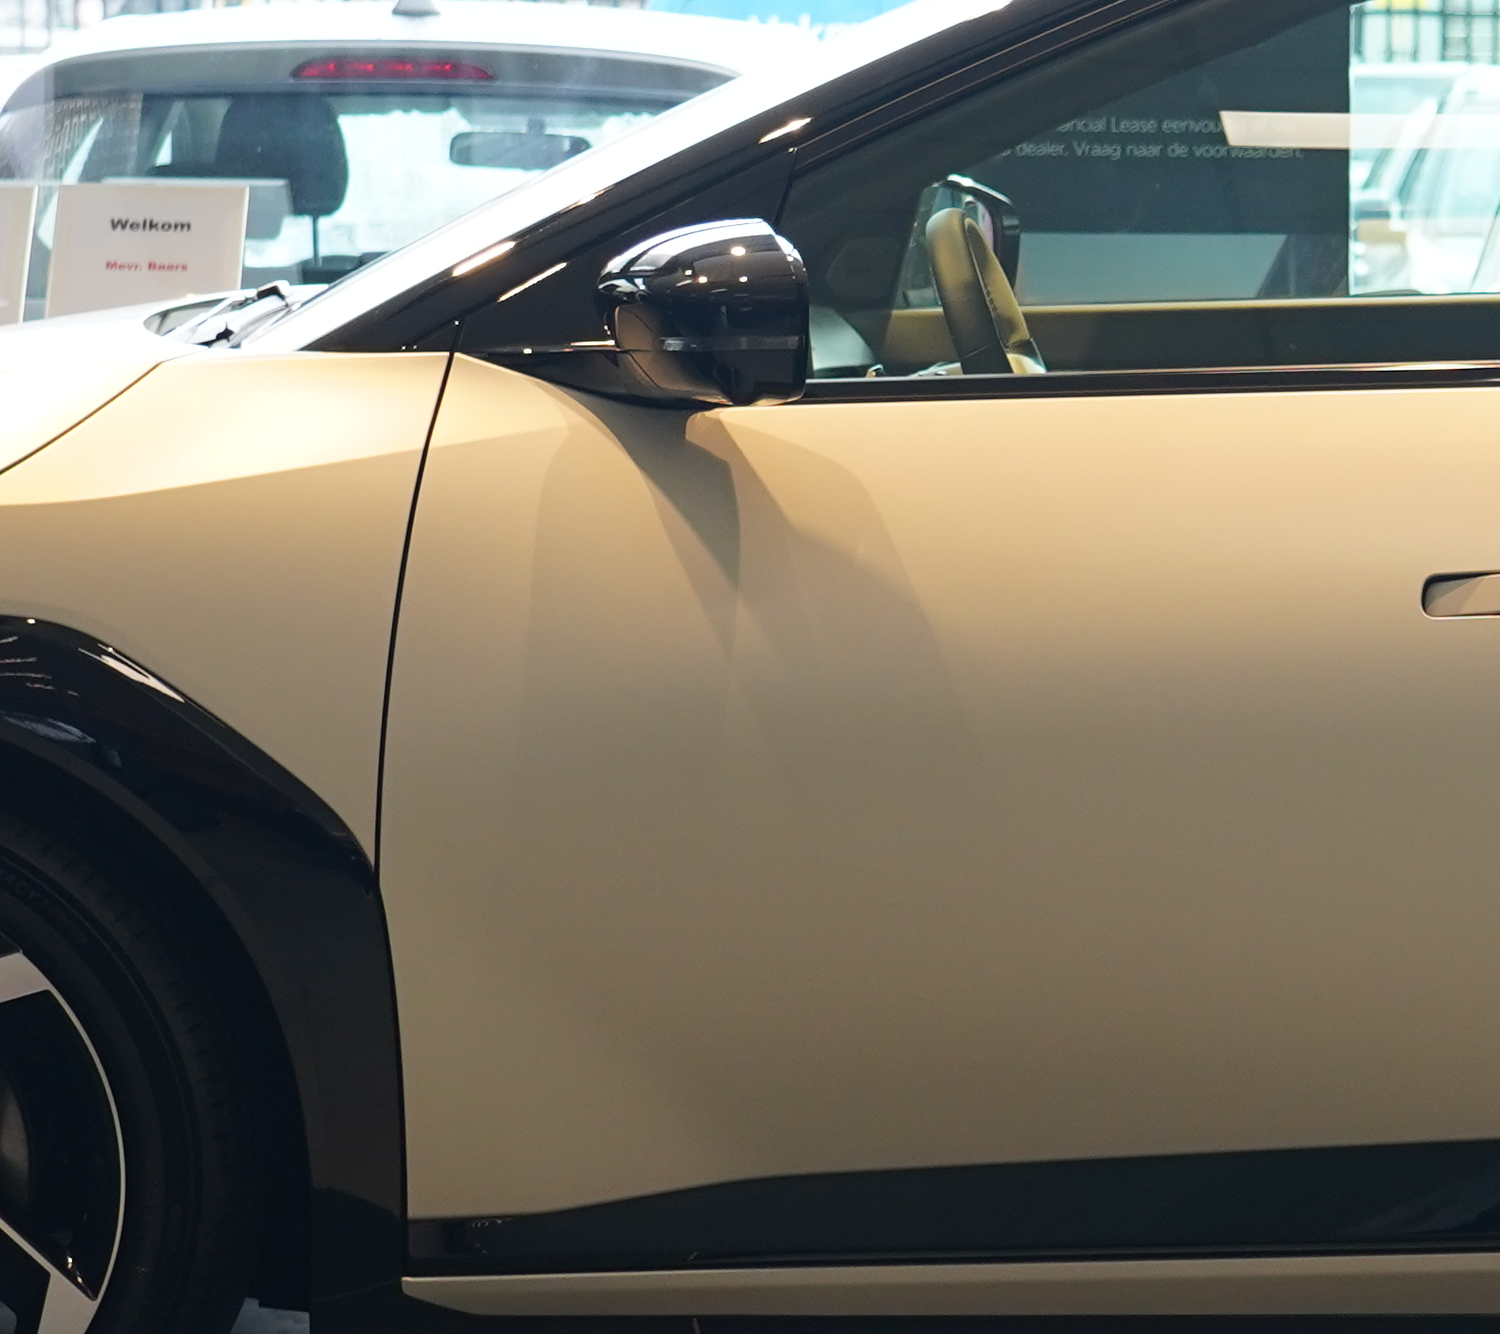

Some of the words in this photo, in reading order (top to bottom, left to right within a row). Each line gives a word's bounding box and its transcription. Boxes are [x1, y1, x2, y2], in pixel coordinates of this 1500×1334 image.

[1111, 117, 1158, 133] Lease
[1074, 141, 1121, 160] Vraag
[1126, 144, 1161, 157] naar
[1167, 142, 1188, 157] de
[110, 217, 192, 233] Welkom
